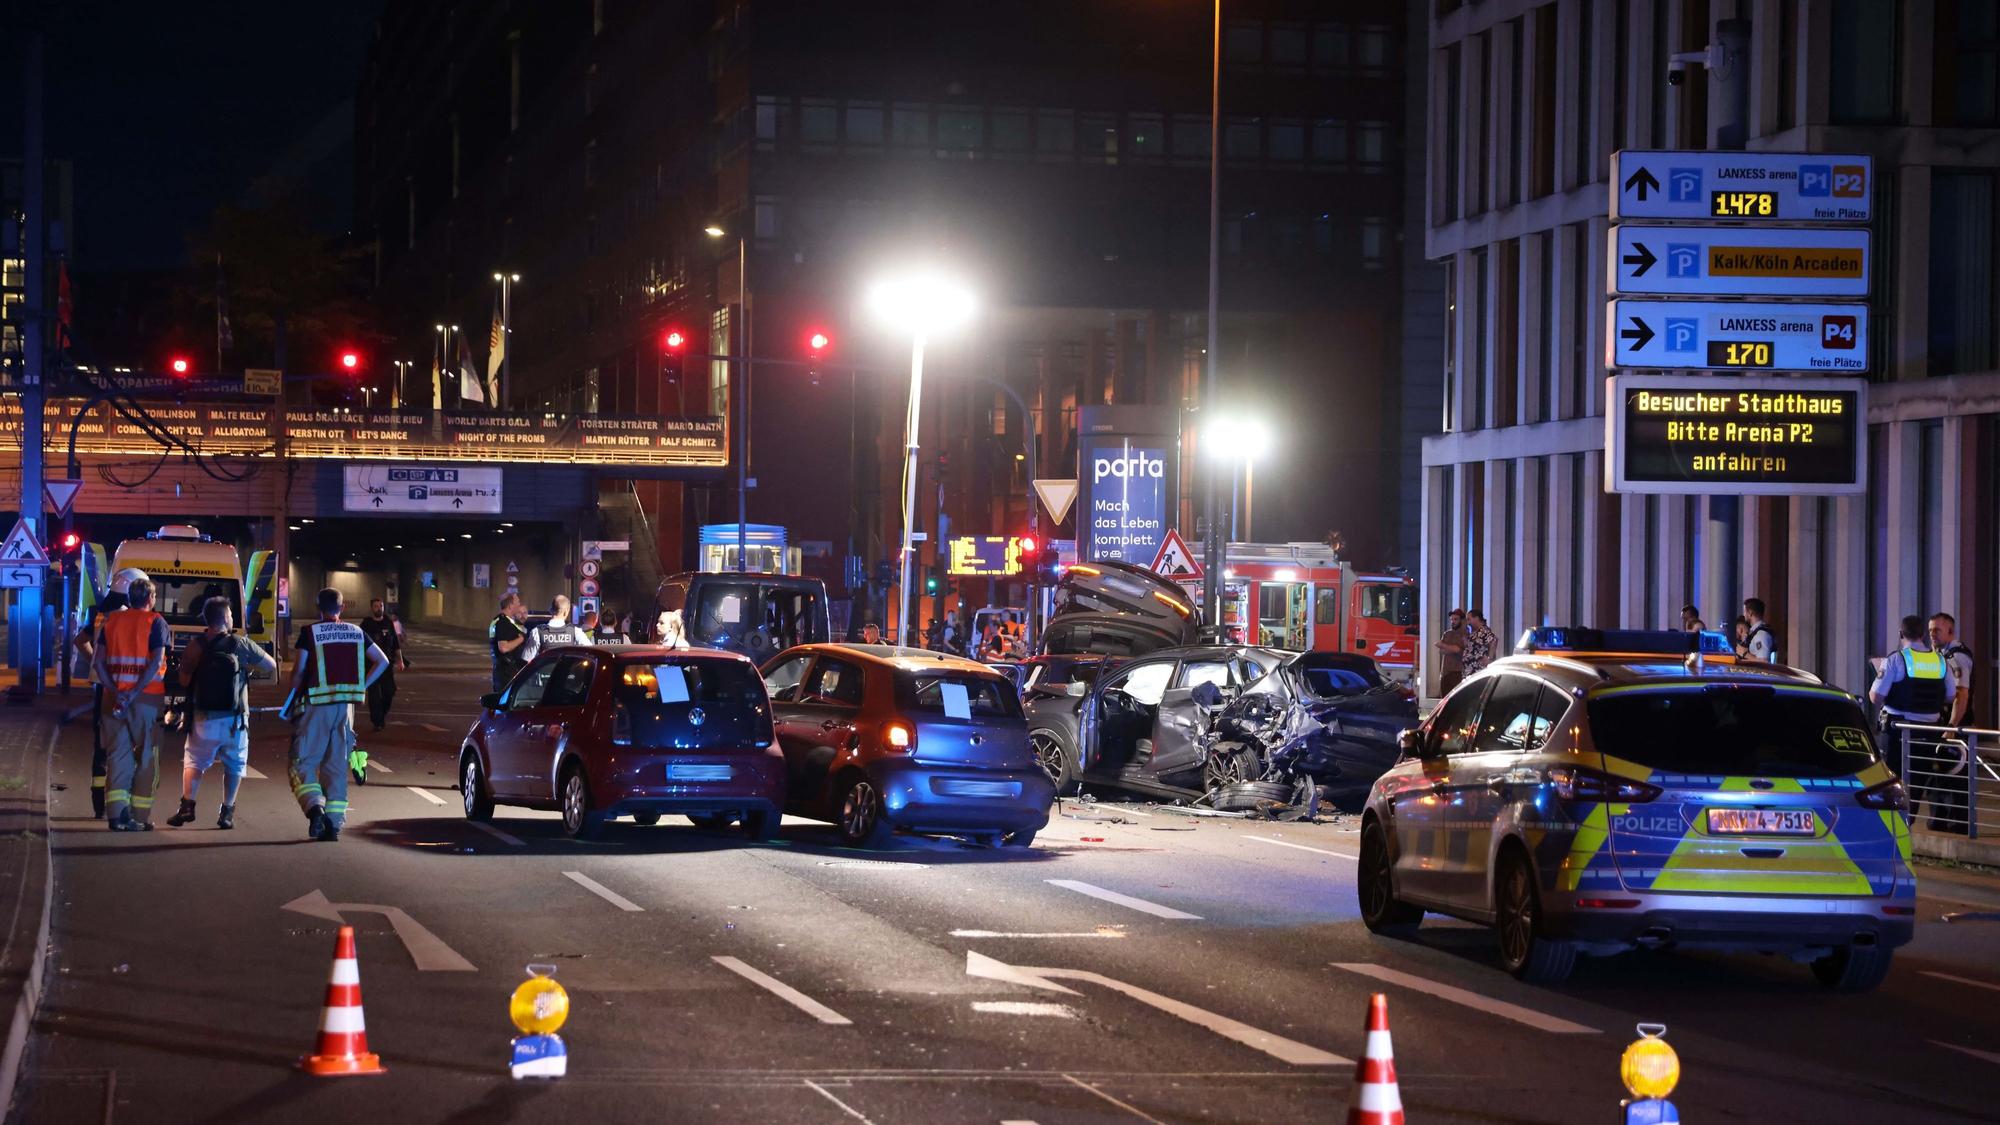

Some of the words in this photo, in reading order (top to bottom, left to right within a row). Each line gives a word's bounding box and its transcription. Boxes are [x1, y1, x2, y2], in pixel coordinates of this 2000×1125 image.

[1718, 168, 1766, 180] LANXESS
[1769, 170, 1798, 181] arena
[1803, 172, 1827, 190] P1
[1834, 174, 1862, 192] P2
[1814, 207, 1836, 219] freie
[1838, 207, 1867, 219] Plätze
[1714, 254, 1789, 271] Kalk/Köln
[1792, 255, 1859, 272] Arcaden
[1720, 318, 1777, 332] LANXESS
[1780, 320, 1814, 333] arena
[1825, 323, 1853, 341] P4
[1726, 344, 1769, 365] 170
[1810, 356, 1832, 368] freie
[1834, 357, 1863, 369] Plätze
[1638, 391, 1731, 413] Besucher
[1738, 393, 1842, 414] Stadthaus
[240, 412, 266, 421] KELLY
[187, 427, 204, 436] XXL
[581, 420, 619, 429] TORSTEN
[621, 420, 658, 430] STRÄTER
[667, 422, 693, 431] MARIO
[214, 427, 266, 437] ALLIGATOAH
[290, 429, 327, 438] KERSTIN
[328, 430, 345, 439] OTT
[356, 431, 379, 440] LET'S
[380, 432, 408, 441] DANCE
[459, 432, 484, 442] NIGHT
[486, 434, 497, 443] OF
[499, 434, 514, 443] THE
[516, 434, 545, 444] PROMS
[1667, 421, 1719, 442] Bitte
[1726, 422, 1783, 443] Arena
[1790, 423, 1813, 443] P2
[585, 435, 616, 445] MARTIN
[618, 435, 649, 446] RÜTTER
[661, 437, 680, 447] RALF
[682, 437, 717, 448] SCHMITZ
[1094, 450, 1163, 484] porta
[1693, 451, 1786, 472] anfahren
[1095, 500, 1130, 512] Mach
[1095, 516, 1117, 529] das
[1121, 516, 1159, 529] Leben
[1095, 533, 1156, 547] komplett.
[543, 633, 572, 643] POLIZEI
[1614, 816, 1683, 832] POLIZEI
